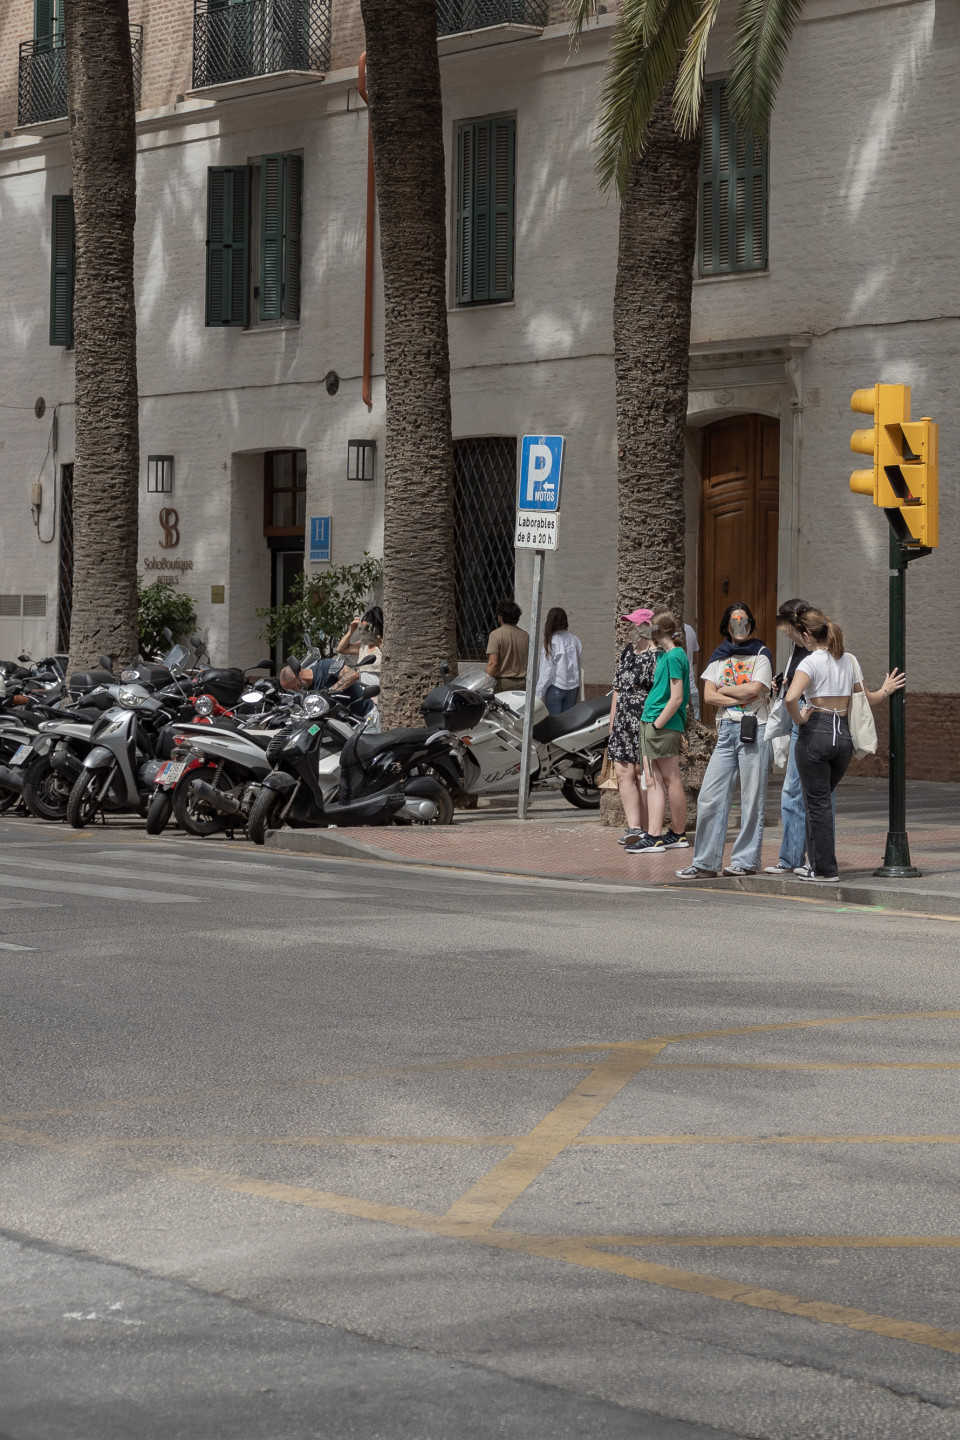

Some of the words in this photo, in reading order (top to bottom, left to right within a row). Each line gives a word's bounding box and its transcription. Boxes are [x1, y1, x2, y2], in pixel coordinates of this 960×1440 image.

[527, 444, 553, 501] P
[534, 491, 555, 502] MOTOS
[315, 520, 325, 541] H
[518, 516, 555, 530] Laborables
[517, 532, 525, 543] de
[526, 532, 531, 543] 8
[532, 535, 537, 543] a
[538, 533, 546, 544] 20
[144, 557, 193, 573] SohoBoutique
